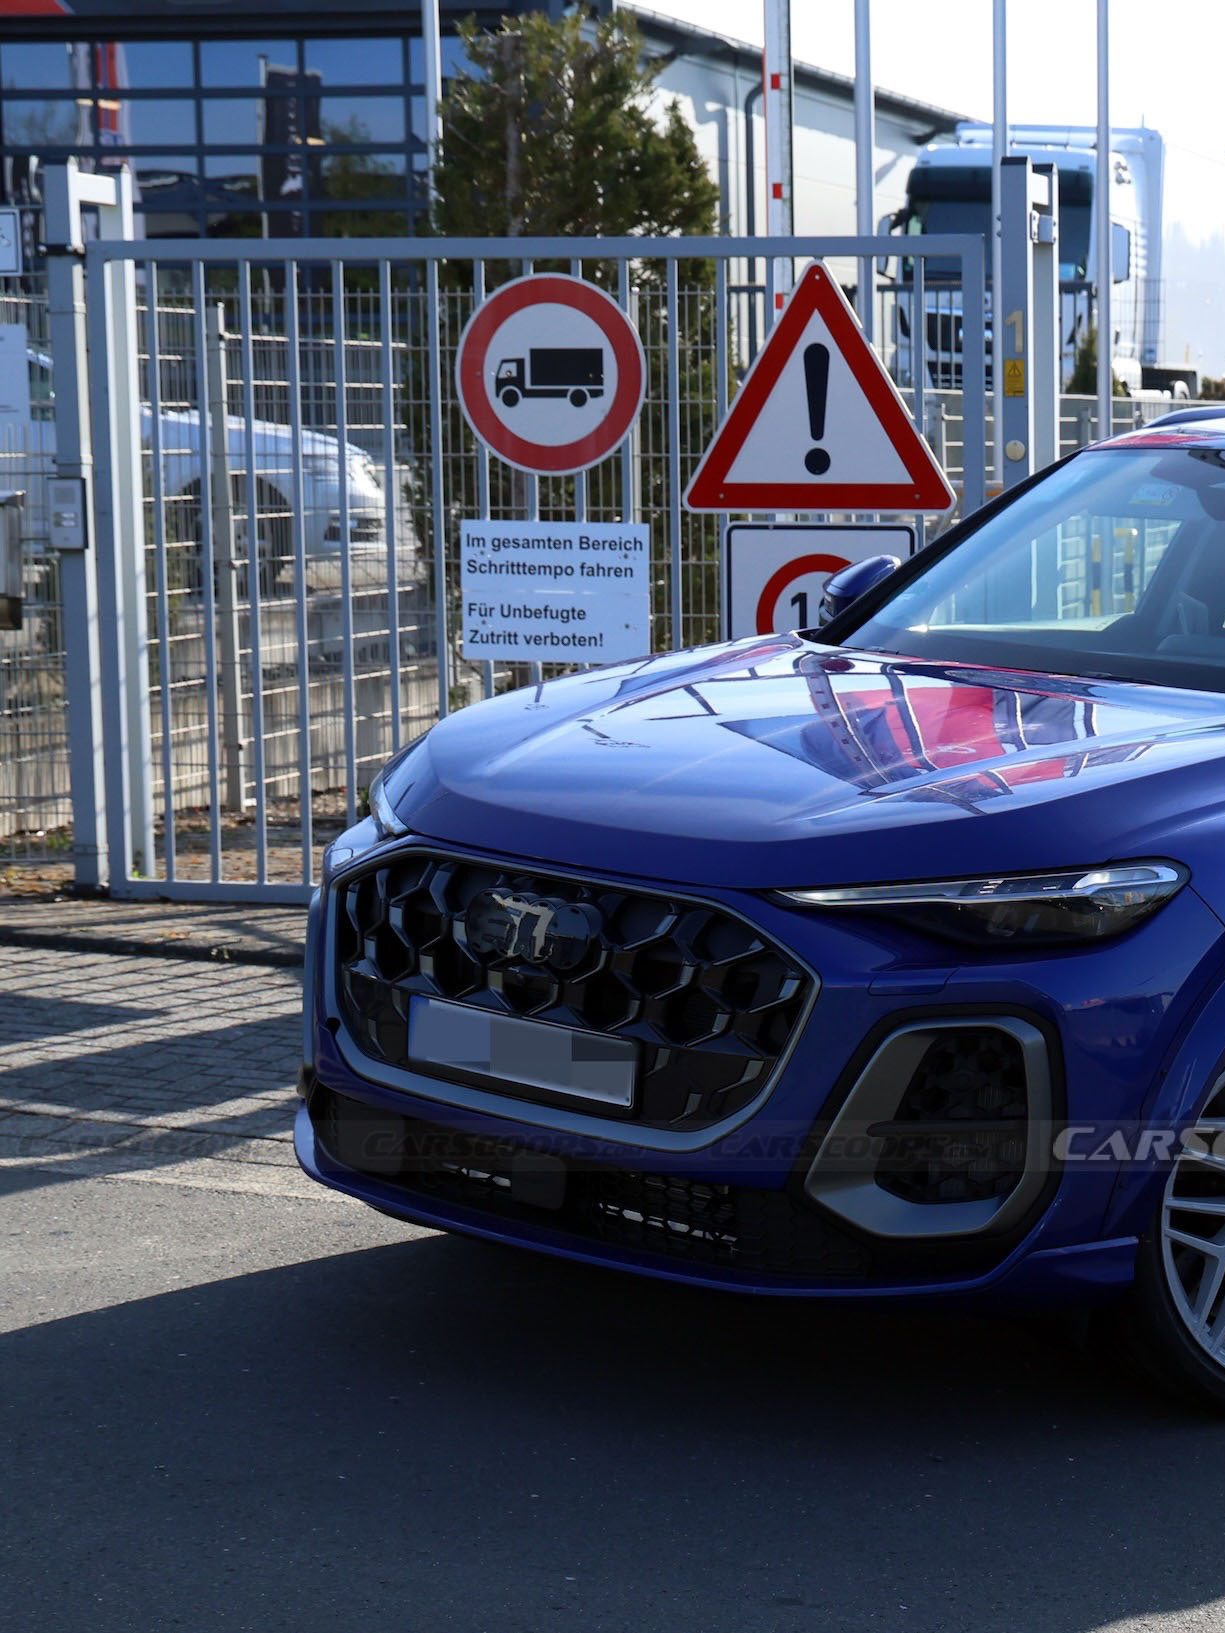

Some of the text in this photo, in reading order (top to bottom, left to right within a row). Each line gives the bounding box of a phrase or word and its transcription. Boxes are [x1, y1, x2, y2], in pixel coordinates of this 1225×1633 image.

[1004, 309, 1024, 353] 1
[466, 534, 643, 552] Im gesamten Bereich
[467, 560, 633, 579] Schritttempo fahren
[468, 603, 586, 622] Für Unbefugte
[469, 630, 603, 647] Zutritt verboten!
